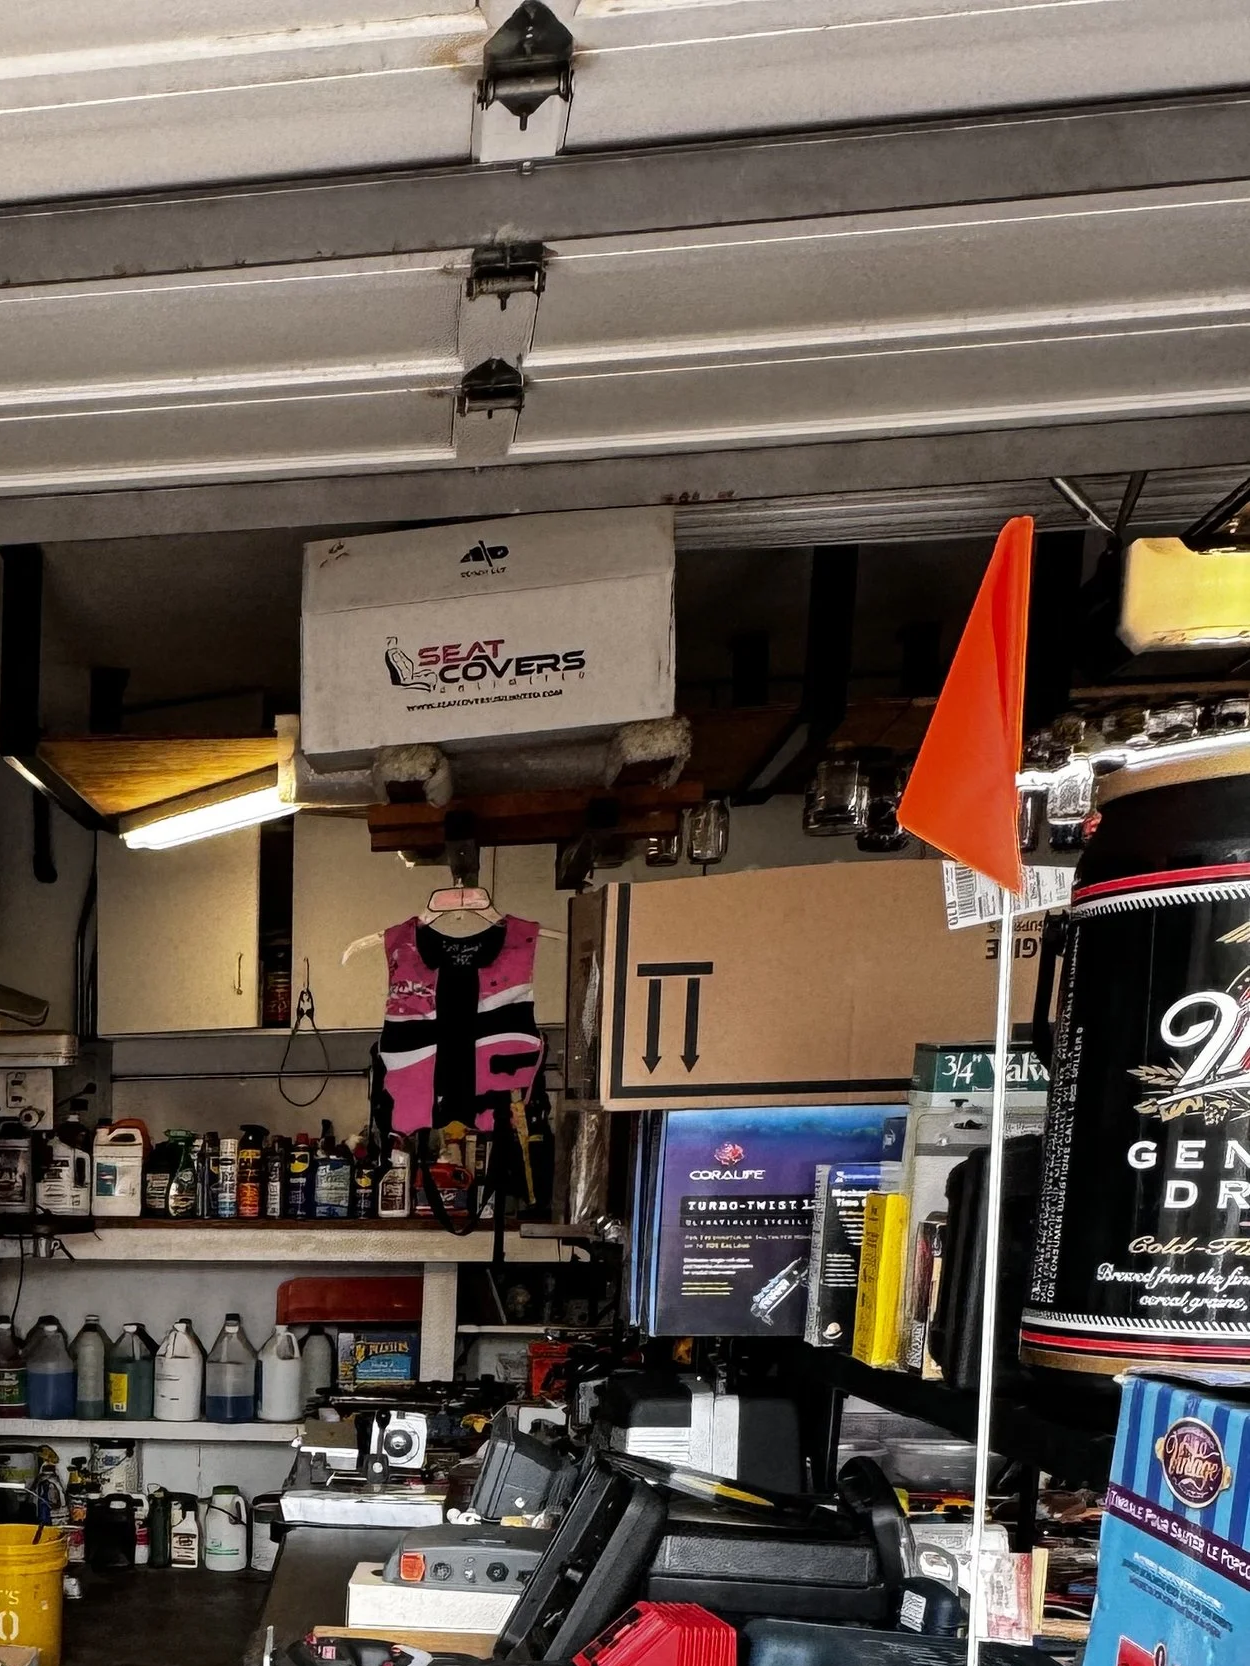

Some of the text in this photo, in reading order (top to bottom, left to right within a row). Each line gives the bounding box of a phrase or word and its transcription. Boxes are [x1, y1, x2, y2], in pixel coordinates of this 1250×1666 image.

[417, 639, 505, 667] SEAT
[438, 650, 586, 684] COVERS
[689, 1169, 767, 1181] CORALIFE
